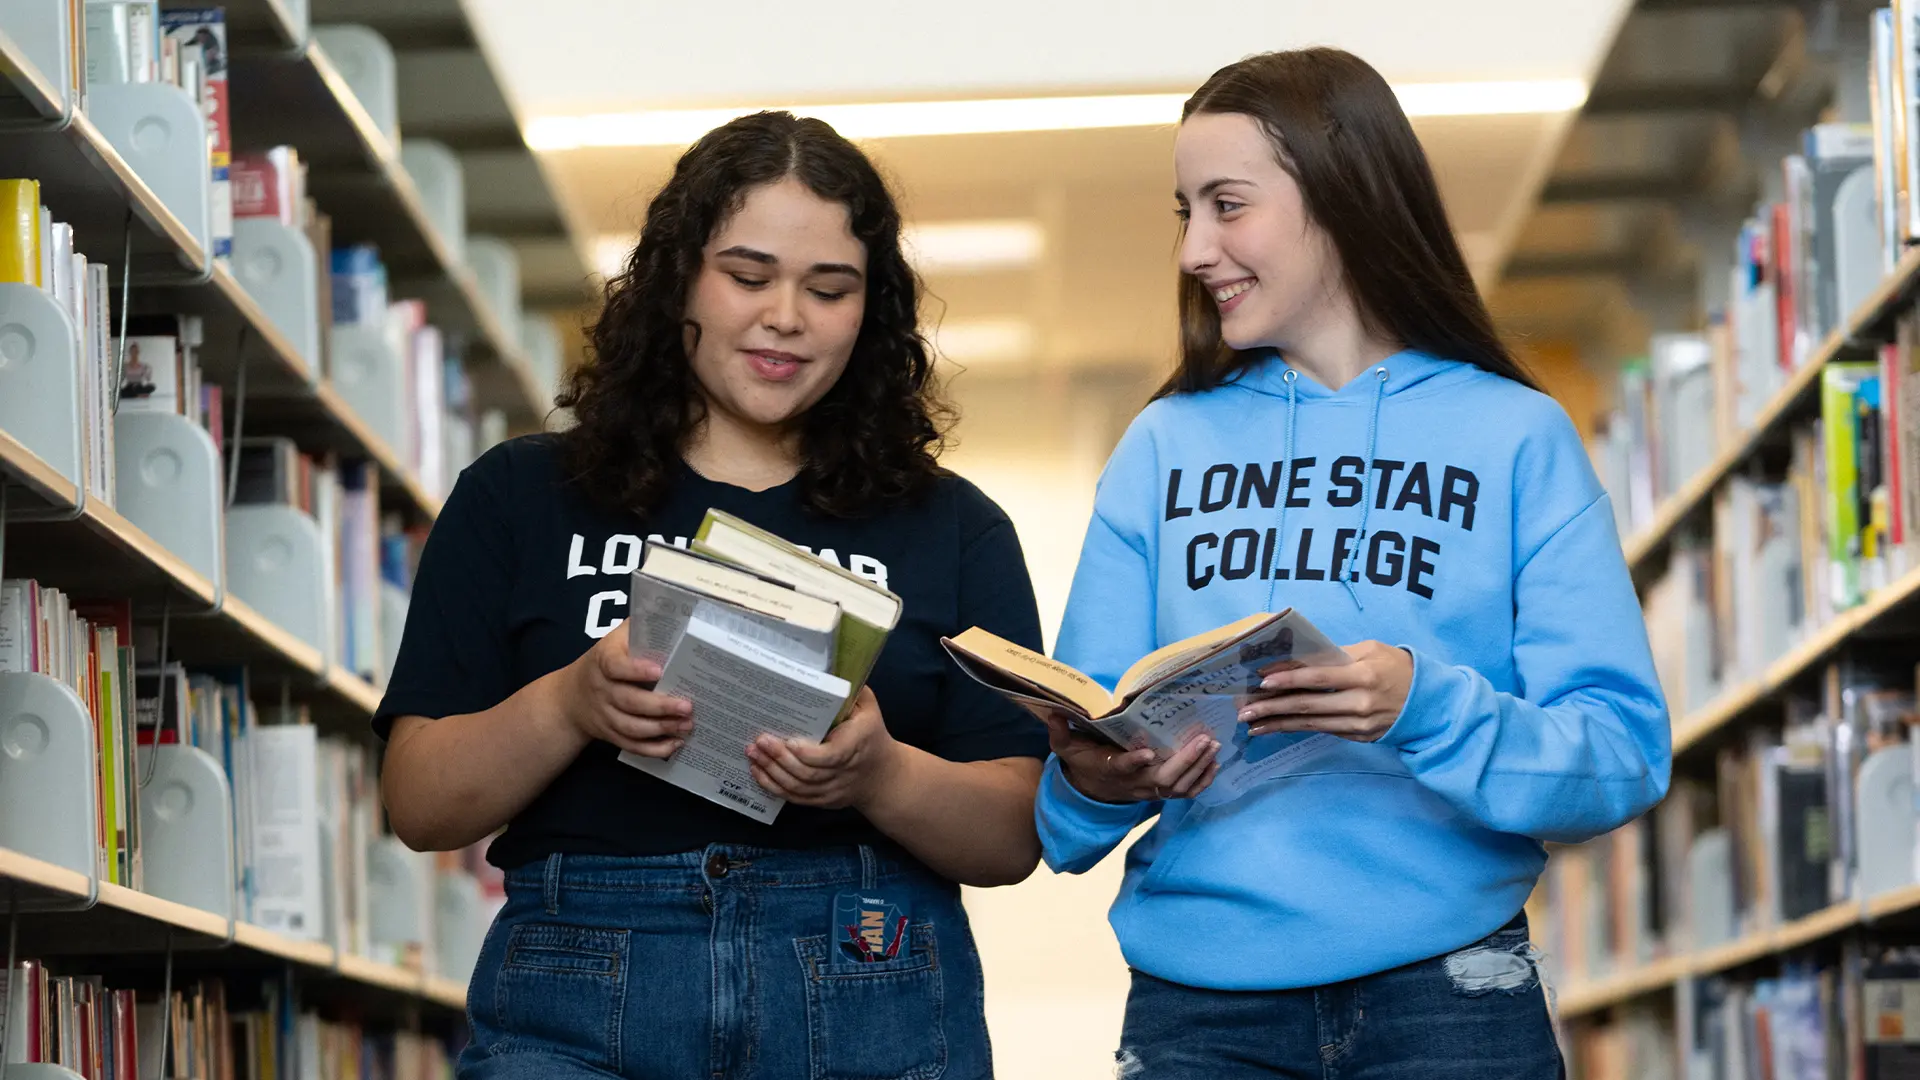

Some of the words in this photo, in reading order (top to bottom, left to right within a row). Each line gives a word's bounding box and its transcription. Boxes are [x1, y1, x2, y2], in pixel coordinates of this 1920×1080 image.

[1165, 456, 1317, 522] LONE
[1327, 455, 1480, 531] STAR
[567, 533, 695, 580] LO
[1186, 528, 1441, 601] COLLEGE
[1149, 698, 1197, 727] Your
